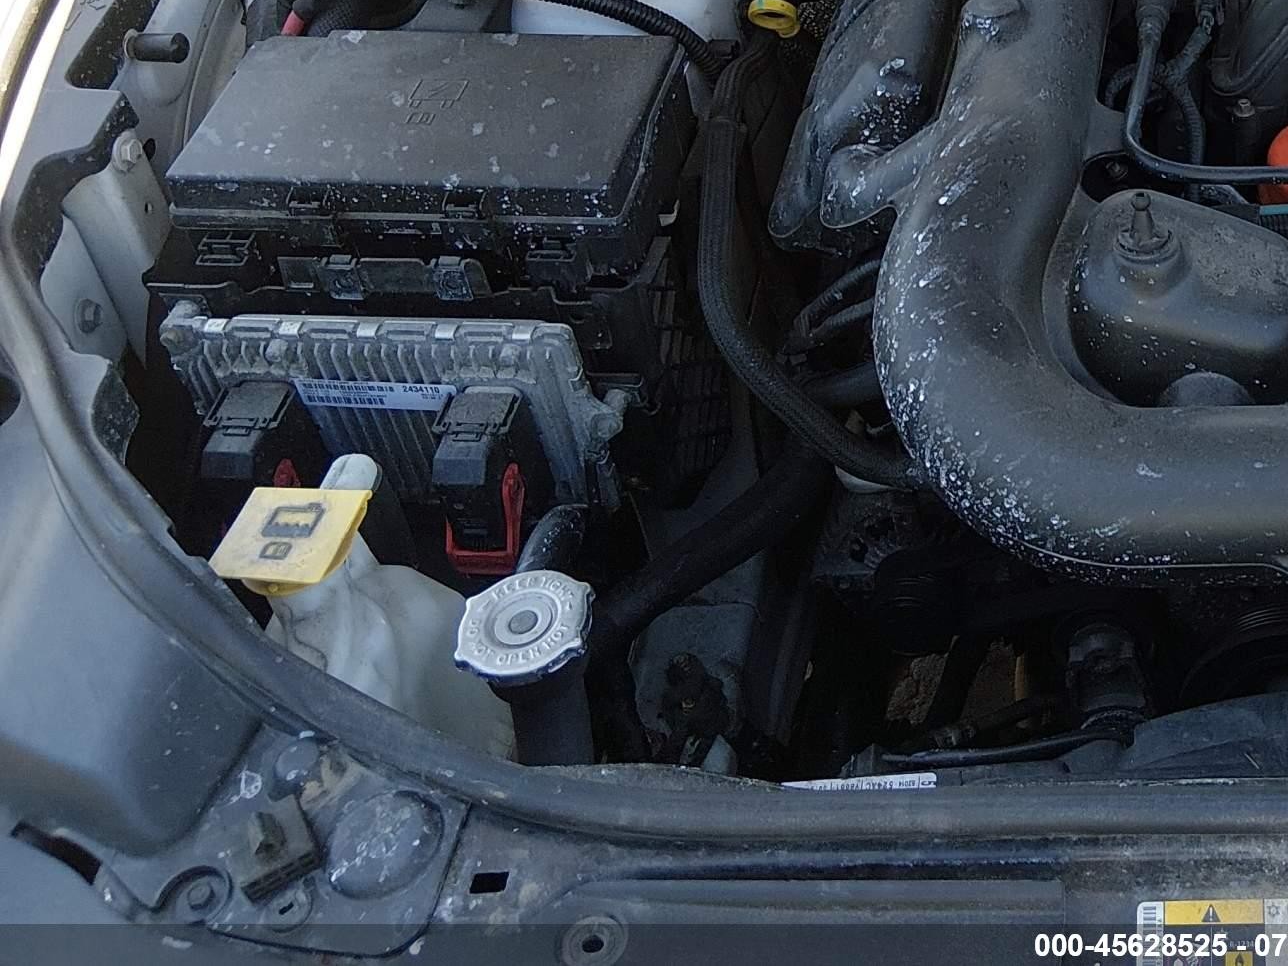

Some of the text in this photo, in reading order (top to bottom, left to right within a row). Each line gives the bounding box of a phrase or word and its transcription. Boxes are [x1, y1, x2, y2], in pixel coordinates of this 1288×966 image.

[402, 385, 440, 394] 2434110
[496, 646, 540, 665] OPEN
[542, 624, 569, 650] HOT
